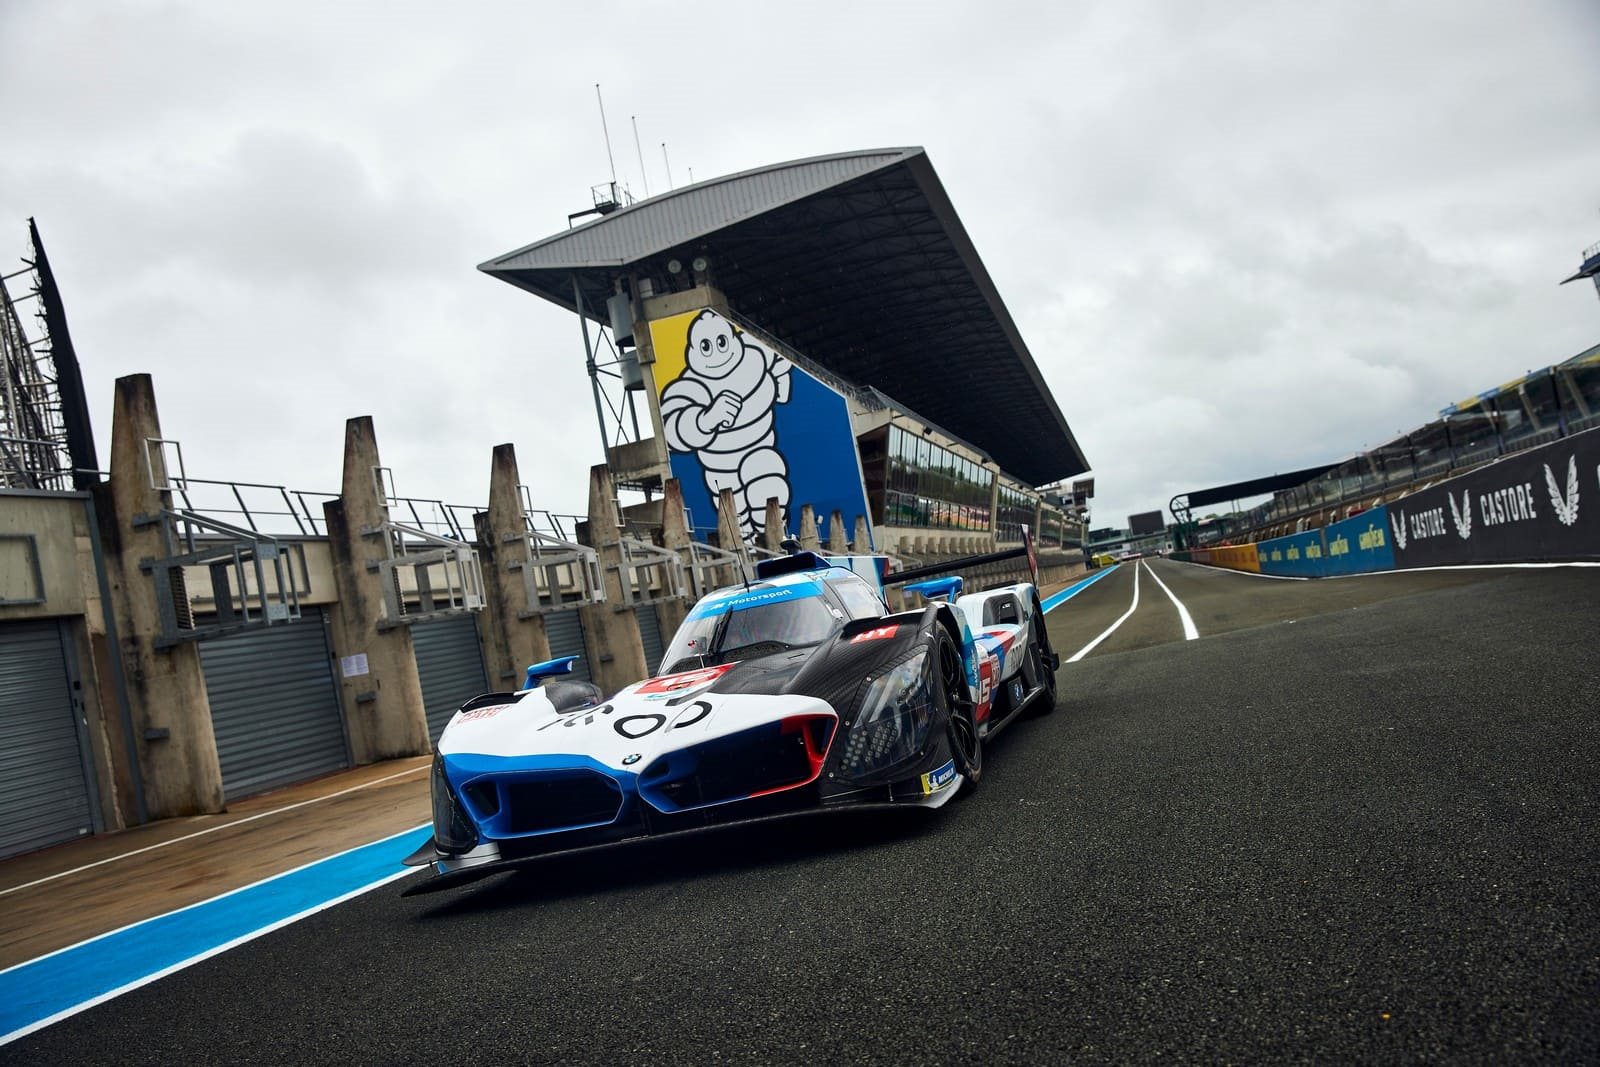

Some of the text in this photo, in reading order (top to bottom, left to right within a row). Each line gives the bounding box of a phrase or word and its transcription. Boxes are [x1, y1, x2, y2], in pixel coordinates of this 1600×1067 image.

[1480, 483, 1537, 527] CASTORE
[1410, 507, 1446, 540] CASTORE
[727, 588, 793, 606] Motorsport
